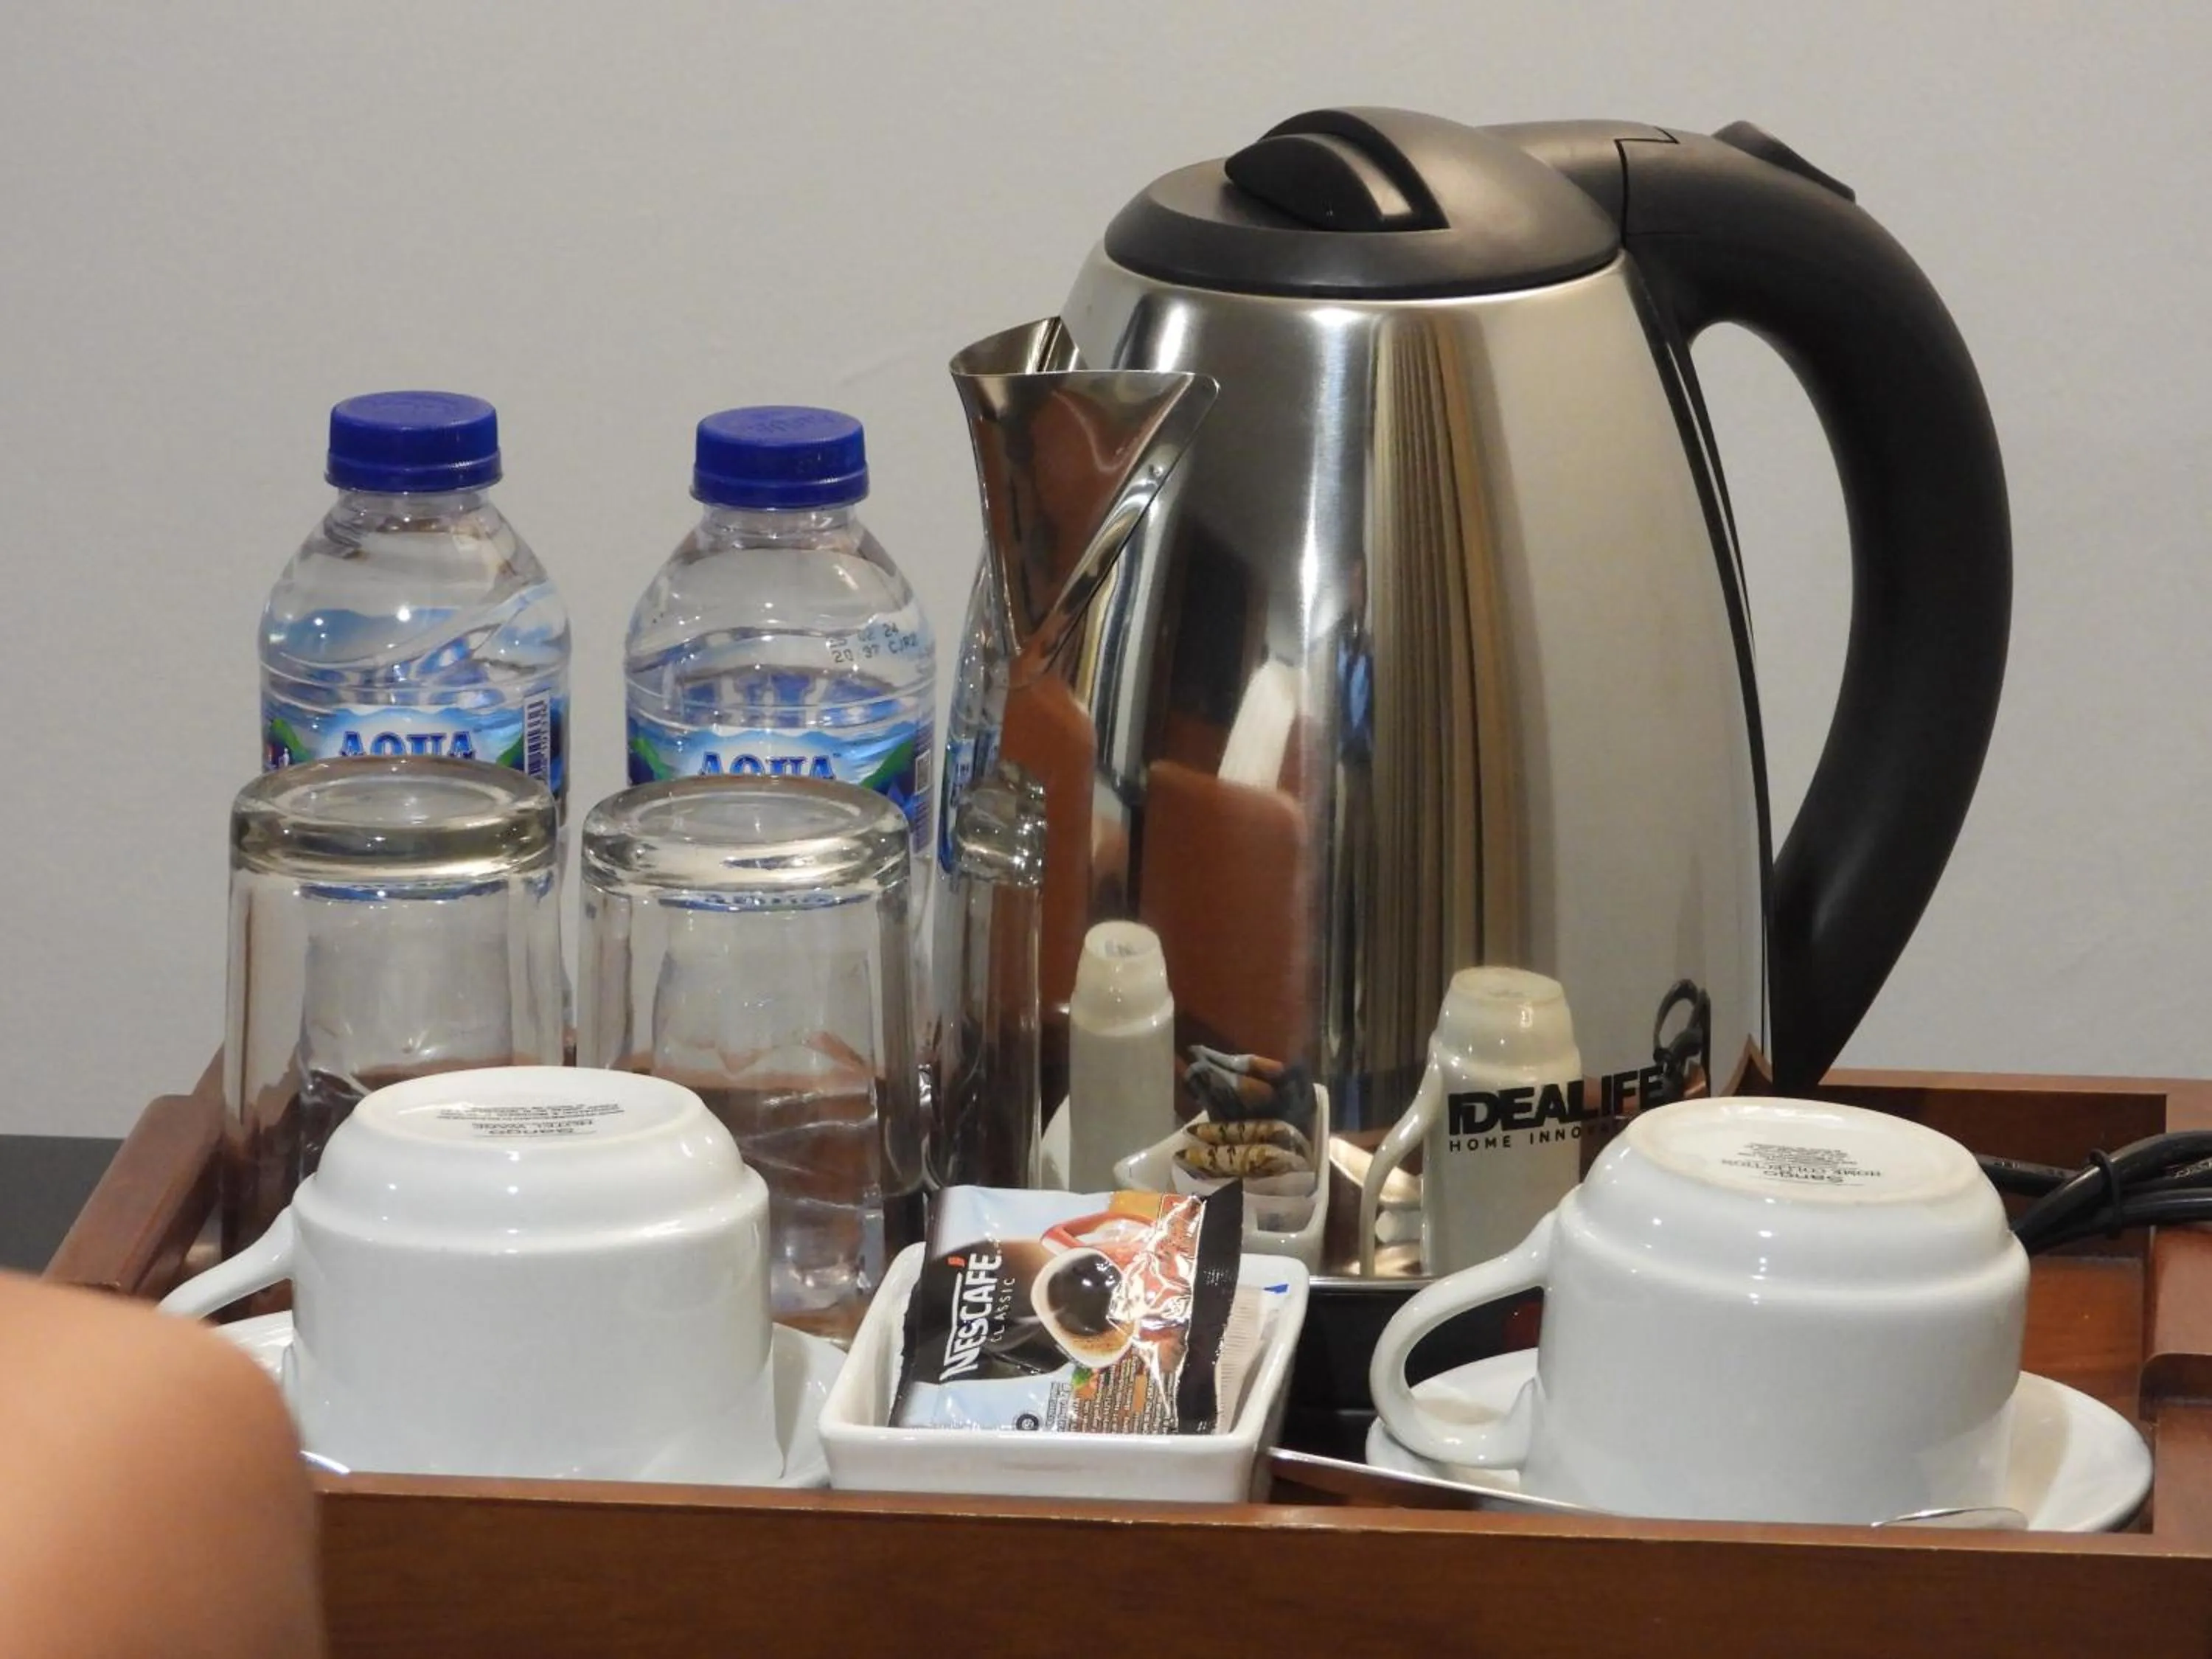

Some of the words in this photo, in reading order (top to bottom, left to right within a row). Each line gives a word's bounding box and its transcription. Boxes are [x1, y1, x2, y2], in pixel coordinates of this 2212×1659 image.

[339, 730, 477, 760] AQUA
[1449, 1134, 1512, 1152] HOME
[990, 1277, 1016, 1343] CLASSIC
